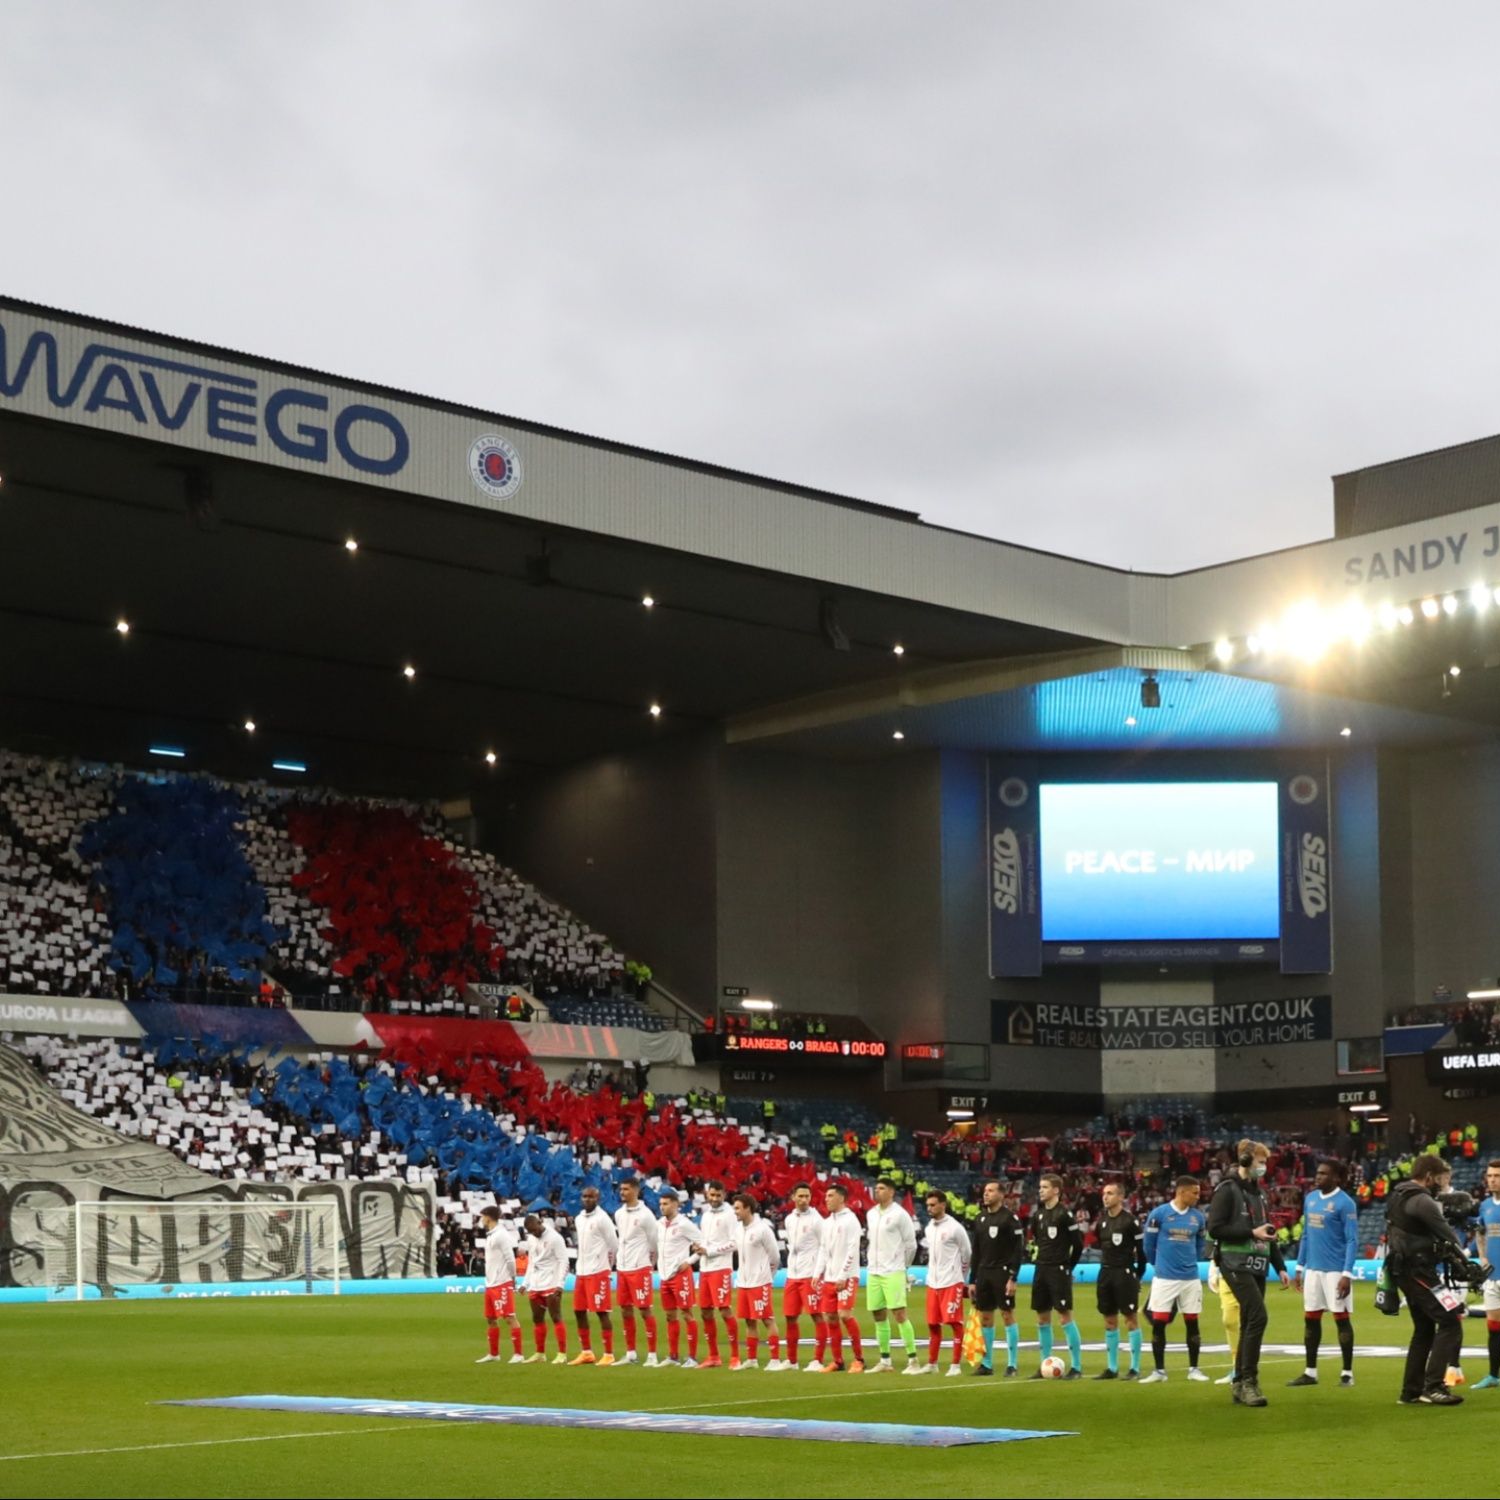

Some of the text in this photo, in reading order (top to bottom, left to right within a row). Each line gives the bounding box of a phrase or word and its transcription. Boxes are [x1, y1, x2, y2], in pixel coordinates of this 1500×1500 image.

[1344, 533, 1468, 586] SANDY
[994, 828, 1018, 914] SEKO
[1065, 850, 1157, 874] PEACE
[1186, 849, 1256, 873] МИР
[1303, 832, 1328, 918] SEKO
[0, 1005, 128, 1025] UROPA LEAGUE
[1036, 999, 1315, 1027] REALESTATEAGENT.CO.UK
[740, 1037, 788, 1050] RANGERS
[805, 1039, 839, 1052] BRAGA
[851, 1042, 885, 1055] 00:00
[1037, 1022, 1315, 1048] THE REAL WAY TO SELL YOUR HOME
[1443, 1056, 1476, 1069] UEFA
[951, 1097, 988, 1107] EXIT 7
[1339, 1091, 1376, 1102] EXIT 8
